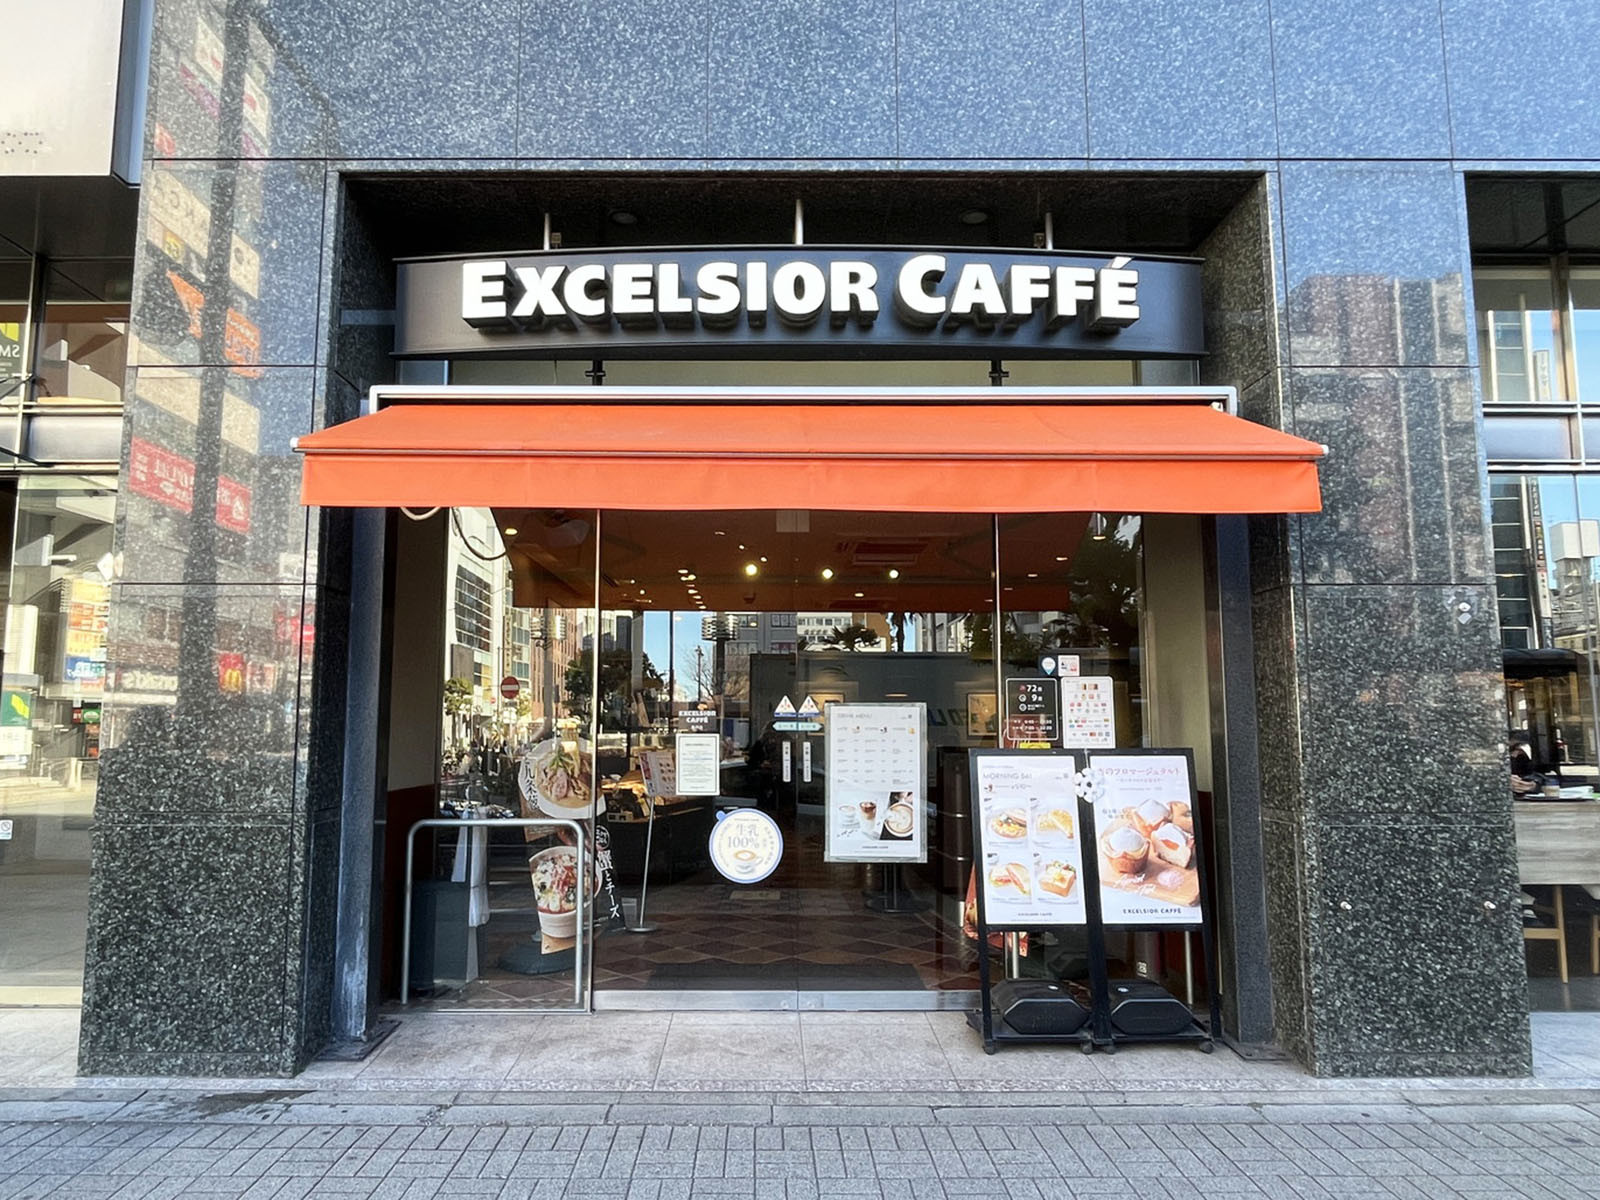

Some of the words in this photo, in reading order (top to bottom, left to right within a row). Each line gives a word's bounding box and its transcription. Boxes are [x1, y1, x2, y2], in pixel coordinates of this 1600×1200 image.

[461, 260, 880, 322] EXCELSIOR
[896, 254, 1140, 320] CAFFÉ
[686, 716, 709, 724] CAFFÉ
[727, 836, 760, 849] 100%
